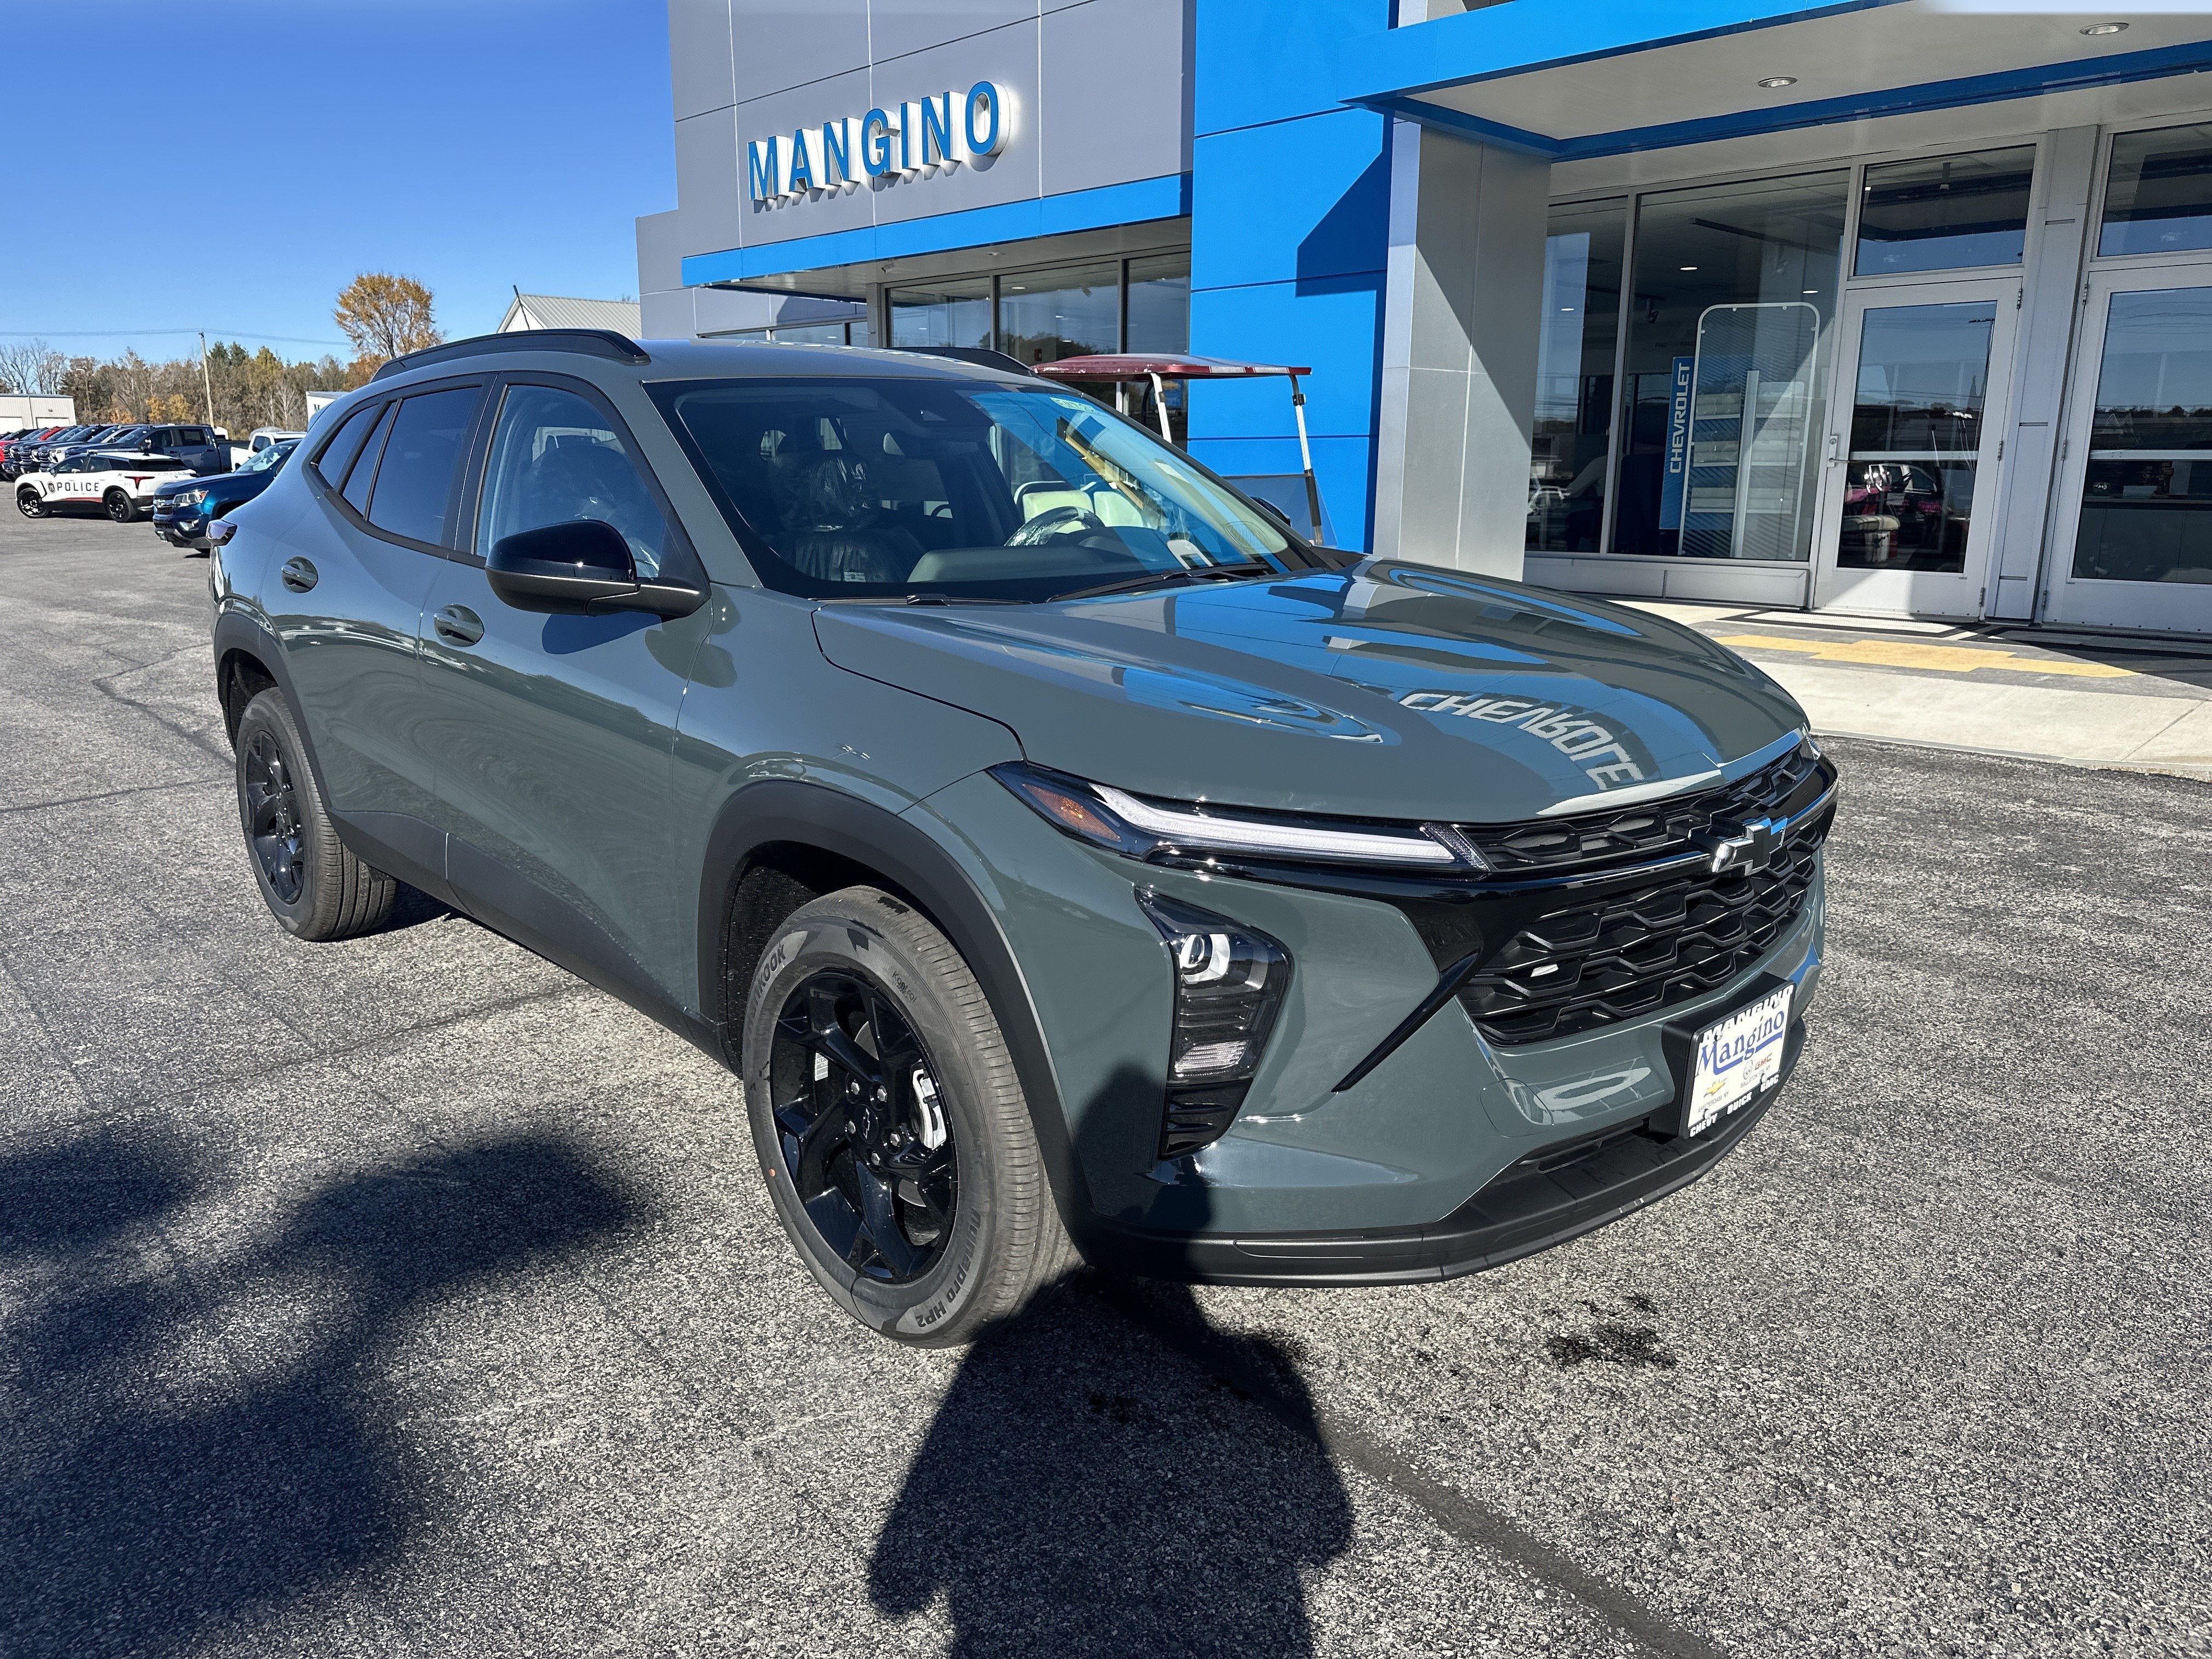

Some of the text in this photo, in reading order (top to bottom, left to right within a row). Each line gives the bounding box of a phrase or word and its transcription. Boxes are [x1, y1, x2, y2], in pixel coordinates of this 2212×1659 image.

[747, 81, 1010, 201] MANGINO
[1670, 362, 1690, 473] CHEVROLET
[57, 482, 99, 492] POLICE
[1695, 1011, 1785, 1077] Mangino
[1702, 985, 1794, 1043] MANGINO
[1754, 1052, 1773, 1070] GMC
[1690, 1074, 1779, 1137] CHEVY BUICK GMC
[916, 1300, 947, 1328] HP2
